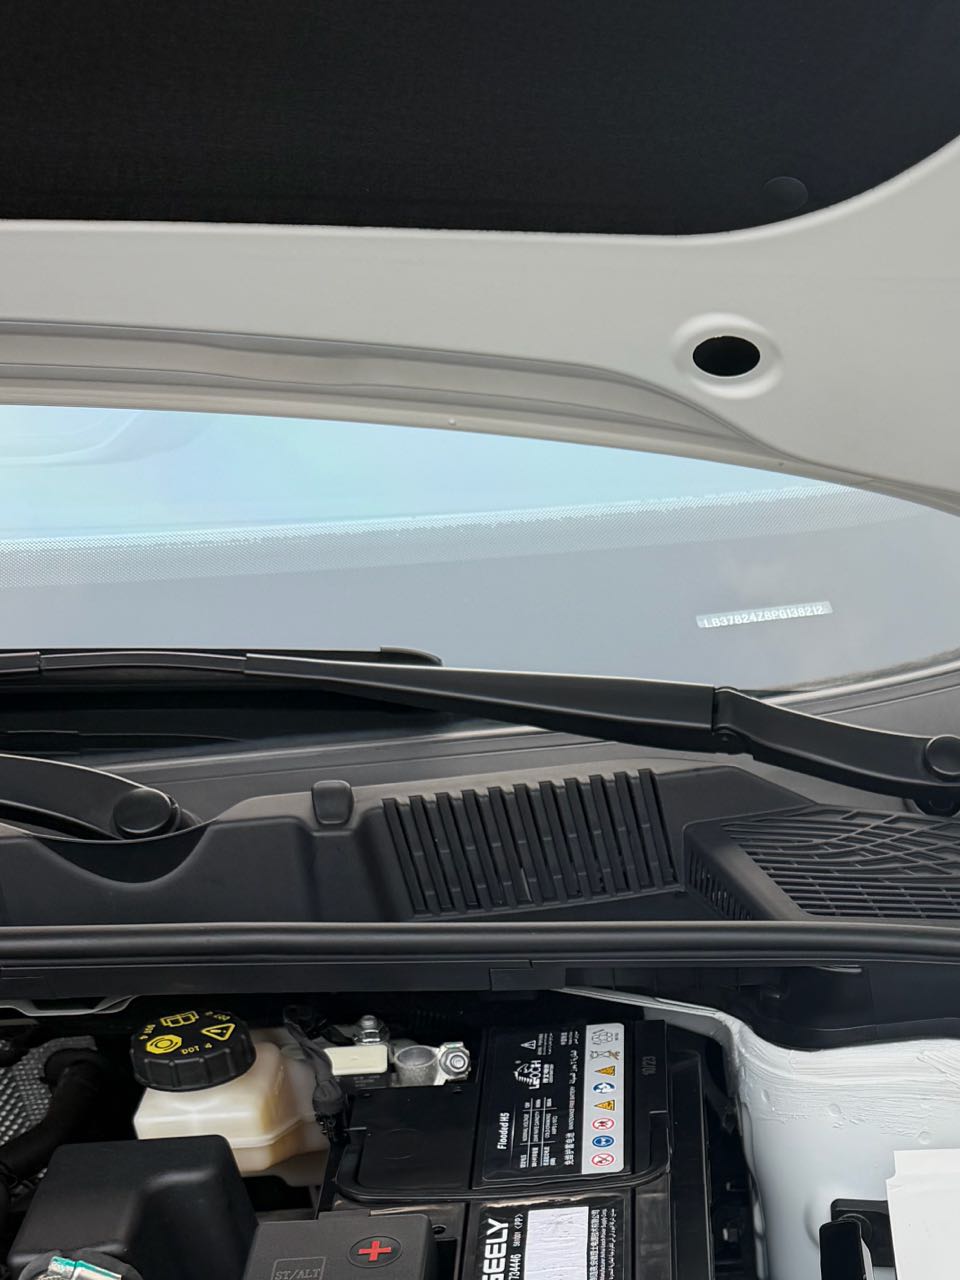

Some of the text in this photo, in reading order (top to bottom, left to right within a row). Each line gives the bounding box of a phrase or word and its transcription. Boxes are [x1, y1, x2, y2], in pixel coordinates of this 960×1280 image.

[703, 605, 824, 628] LB37824Z8PG138212
[181, 1045, 200, 1055] DOT
[497, 1112, 510, 1150] Flooded H5
[274, 1268, 321, 1280] ST/ALT
